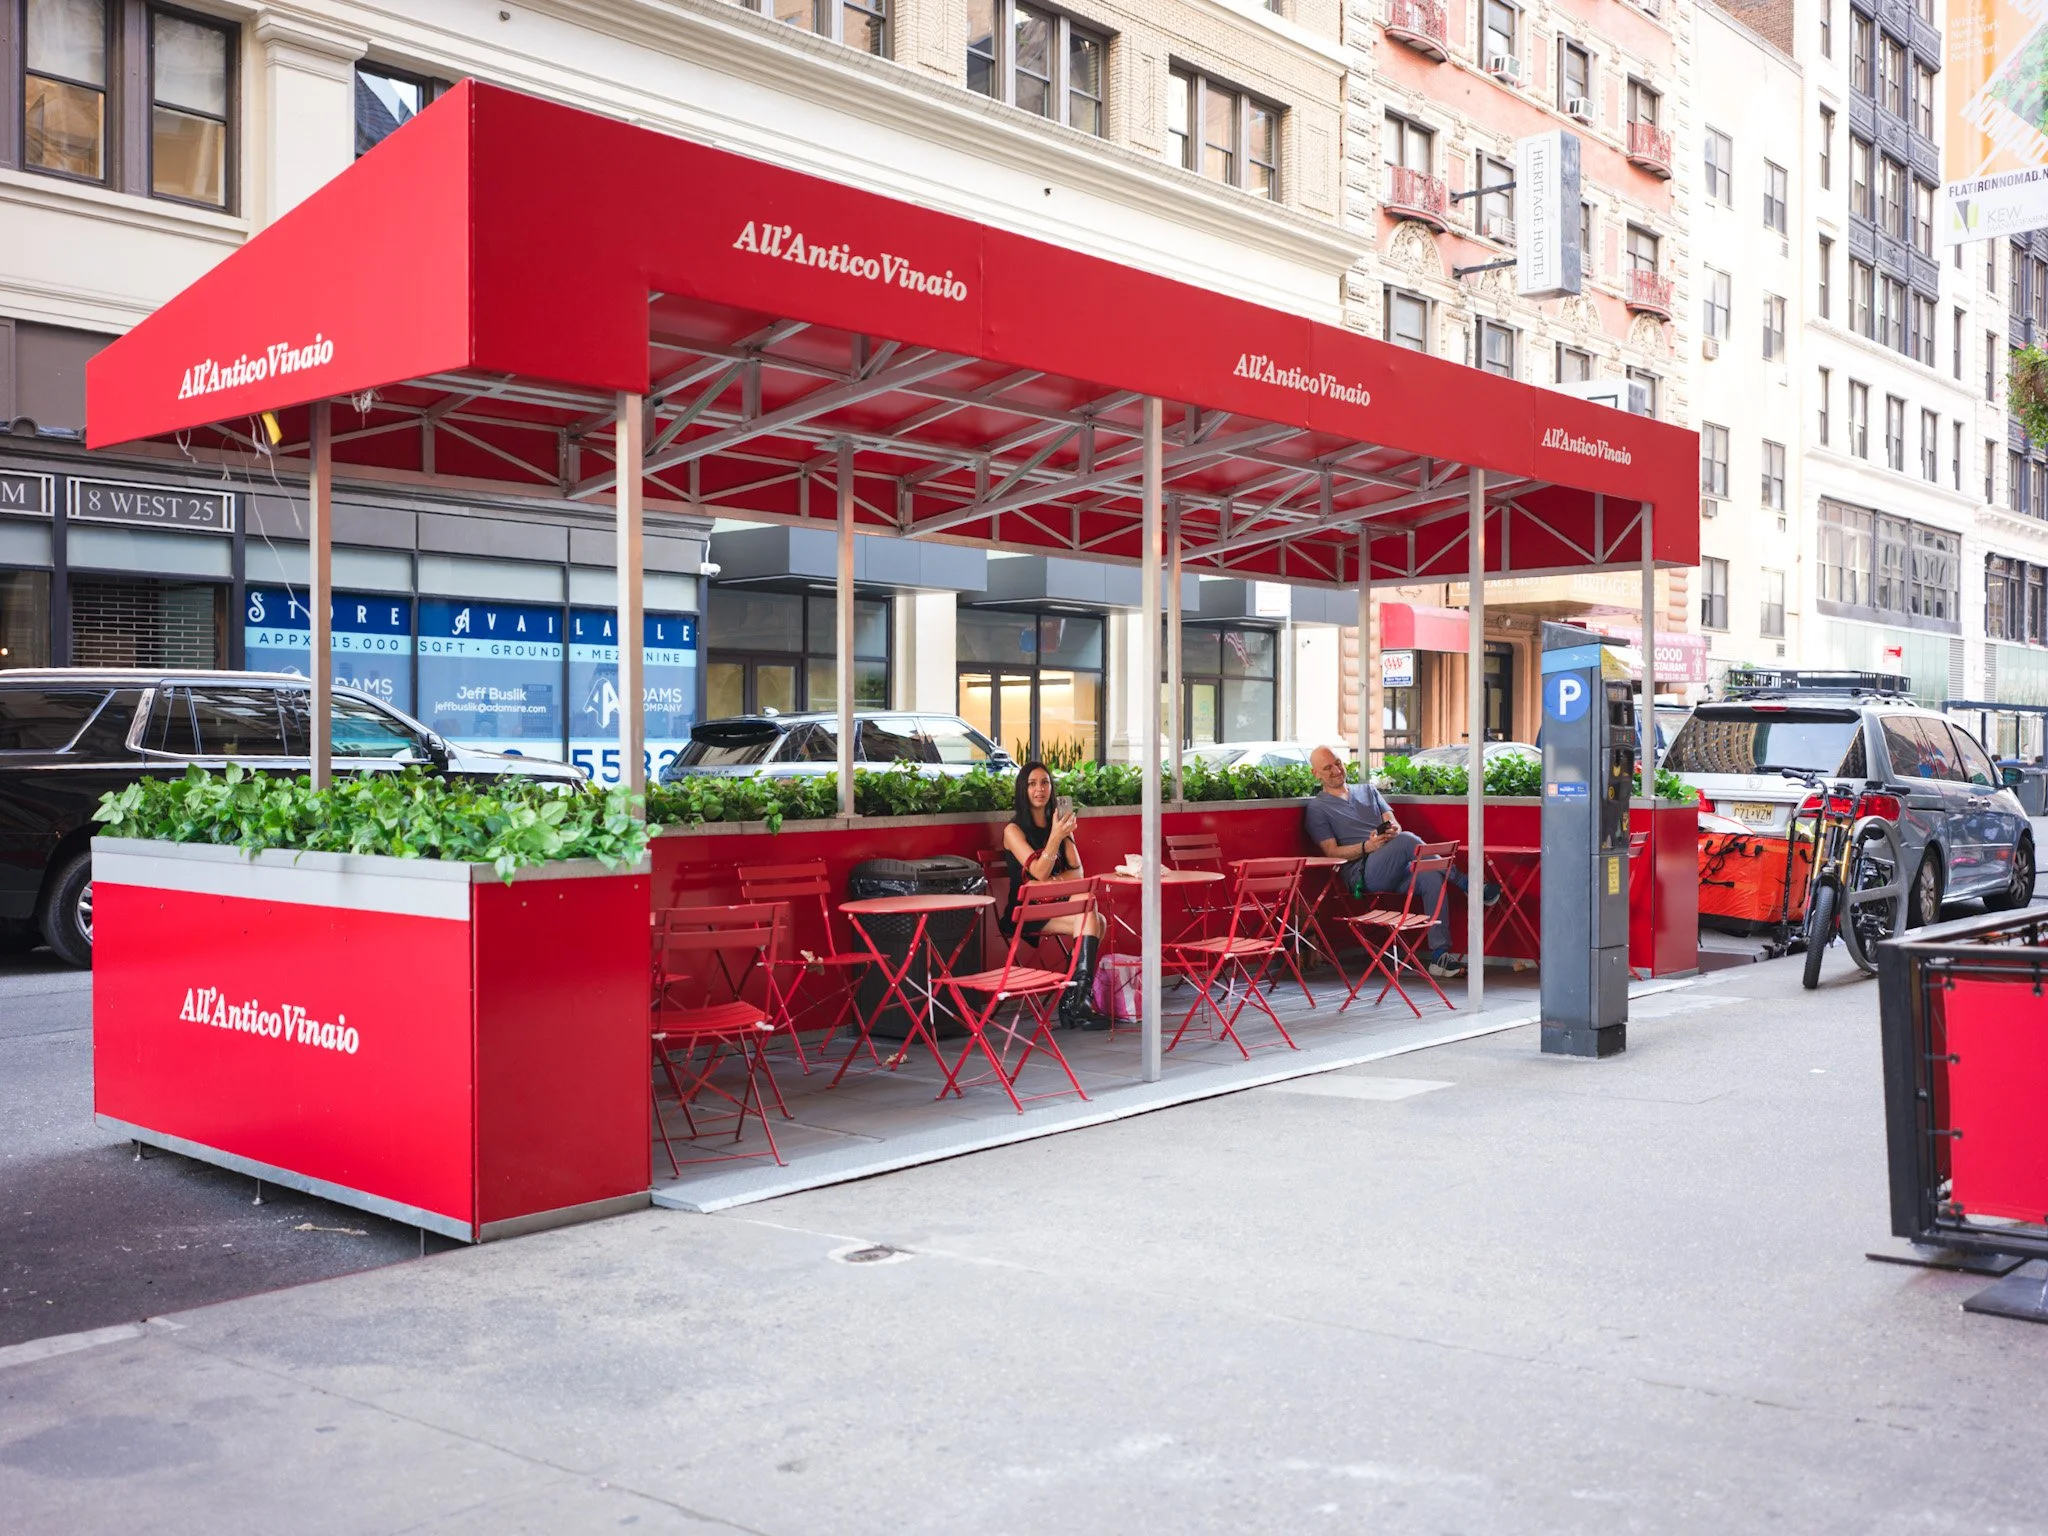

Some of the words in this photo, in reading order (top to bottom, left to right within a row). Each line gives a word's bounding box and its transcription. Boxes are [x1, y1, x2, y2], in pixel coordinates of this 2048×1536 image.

[1533, 150, 1544, 226] HERITAGE
[1987, 204, 2023, 223] KEW
[1533, 230, 1544, 280] HOTEL
[88, 489, 101, 511] 8
[110, 492, 183, 518] WEST
[188, 499, 214, 521] 25
[1574, 574, 1628, 597] HERITAGE
[248, 591, 399, 626] STRE
[452, 608, 690, 642] AVAILALE
[332, 637, 399, 651] 15,000
[419, 641, 465, 653] SQFT
[491, 644, 561, 657] GROUND
[1654, 647, 1683, 661] GOOD
[334, 676, 393, 695] DAMS
[457, 686, 487, 700] Jeff
[488, 687, 527, 701] Buslik
[643, 688, 682, 703] AMS
[1559, 679, 1582, 716] P
[434, 701, 547, 714] jeffbuslik@adamsre.com
[643, 704, 682, 713] OMPANY
